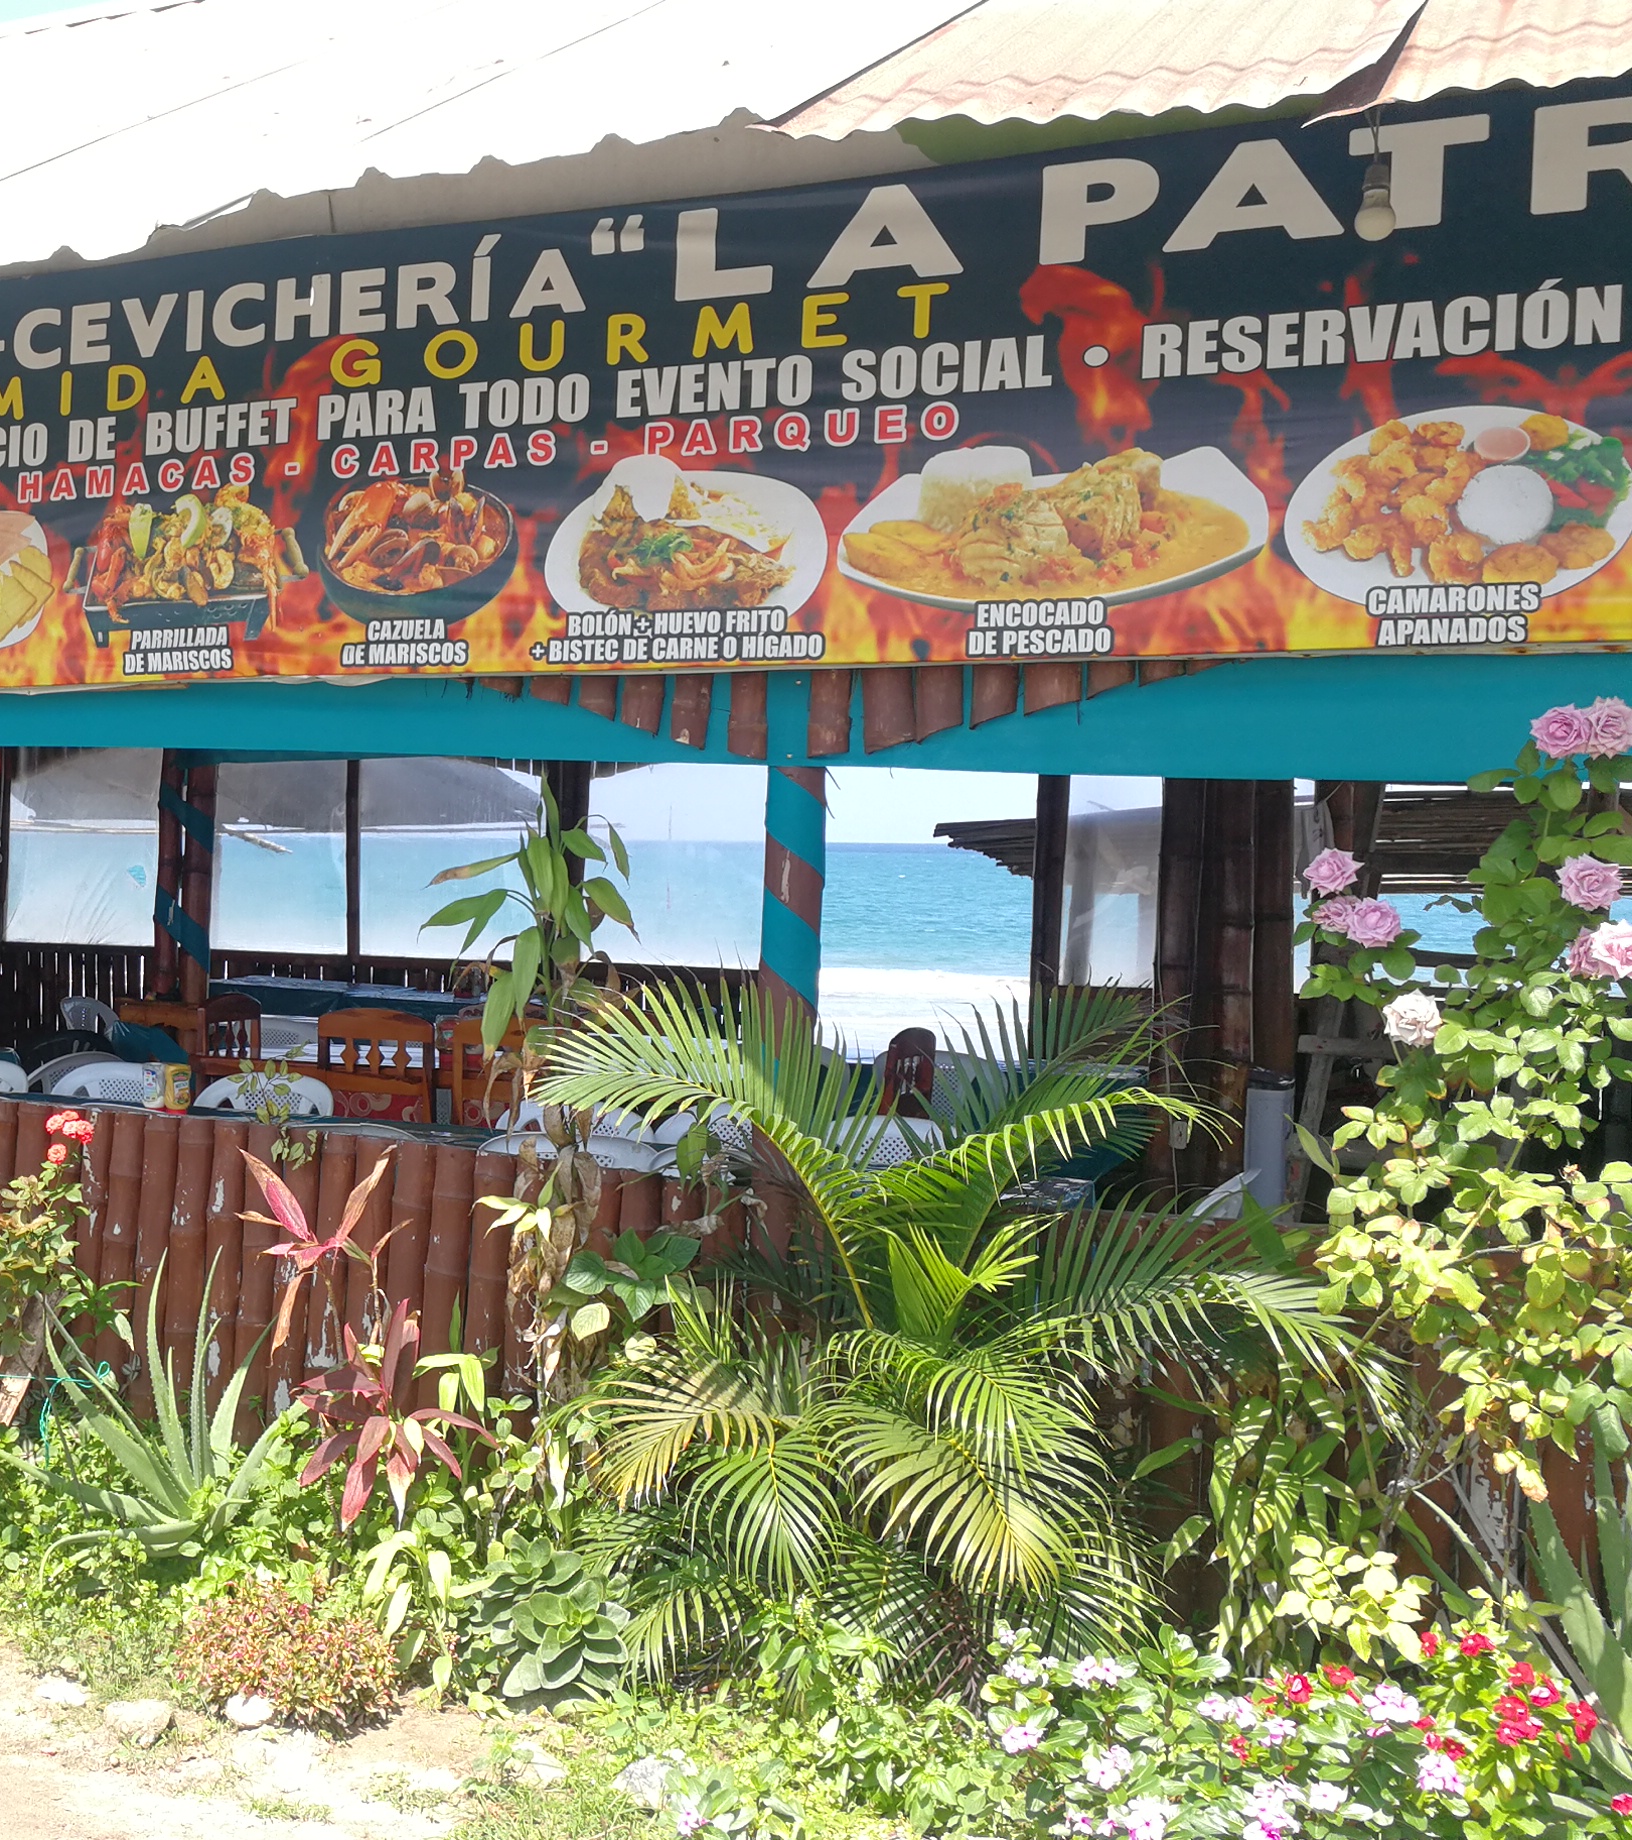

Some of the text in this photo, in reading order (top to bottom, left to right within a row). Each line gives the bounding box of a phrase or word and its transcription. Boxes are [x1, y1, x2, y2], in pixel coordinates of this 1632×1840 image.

[329, 282, 950, 388] GOURMET
[68, 416, 117, 463] DE
[145, 397, 297, 457] BUFFET
[317, 386, 437, 441] PARA
[459, 372, 590, 429] TODO
[616, 354, 813, 419] EVENTO
[841, 334, 1053, 402] SOCIAL
[1141, 277, 1623, 380] RESERVACIÓN
[17, 451, 256, 503] HAMACAS
[331, 429, 557, 480] CARPAS
[644, 401, 960, 456] PARQUEO
[1368, 583, 1540, 615] CAMARONES
[568, 609, 785, 636] BOLÓN HUEVO FRITO
[977, 600, 1104, 628] ENCOCADO
[131, 627, 228, 650] PARRILLADA
[367, 619, 445, 641] CAZUELA
[968, 627, 1111, 655] DE PESCADO
[1377, 615, 1526, 646] APANADOS
[342, 642, 467, 665] DE MARISCOS
[548, 631, 824, 662] BISTEC DE CARNE O HÍGADO
[125, 649, 232, 674] DE MARISCOS
